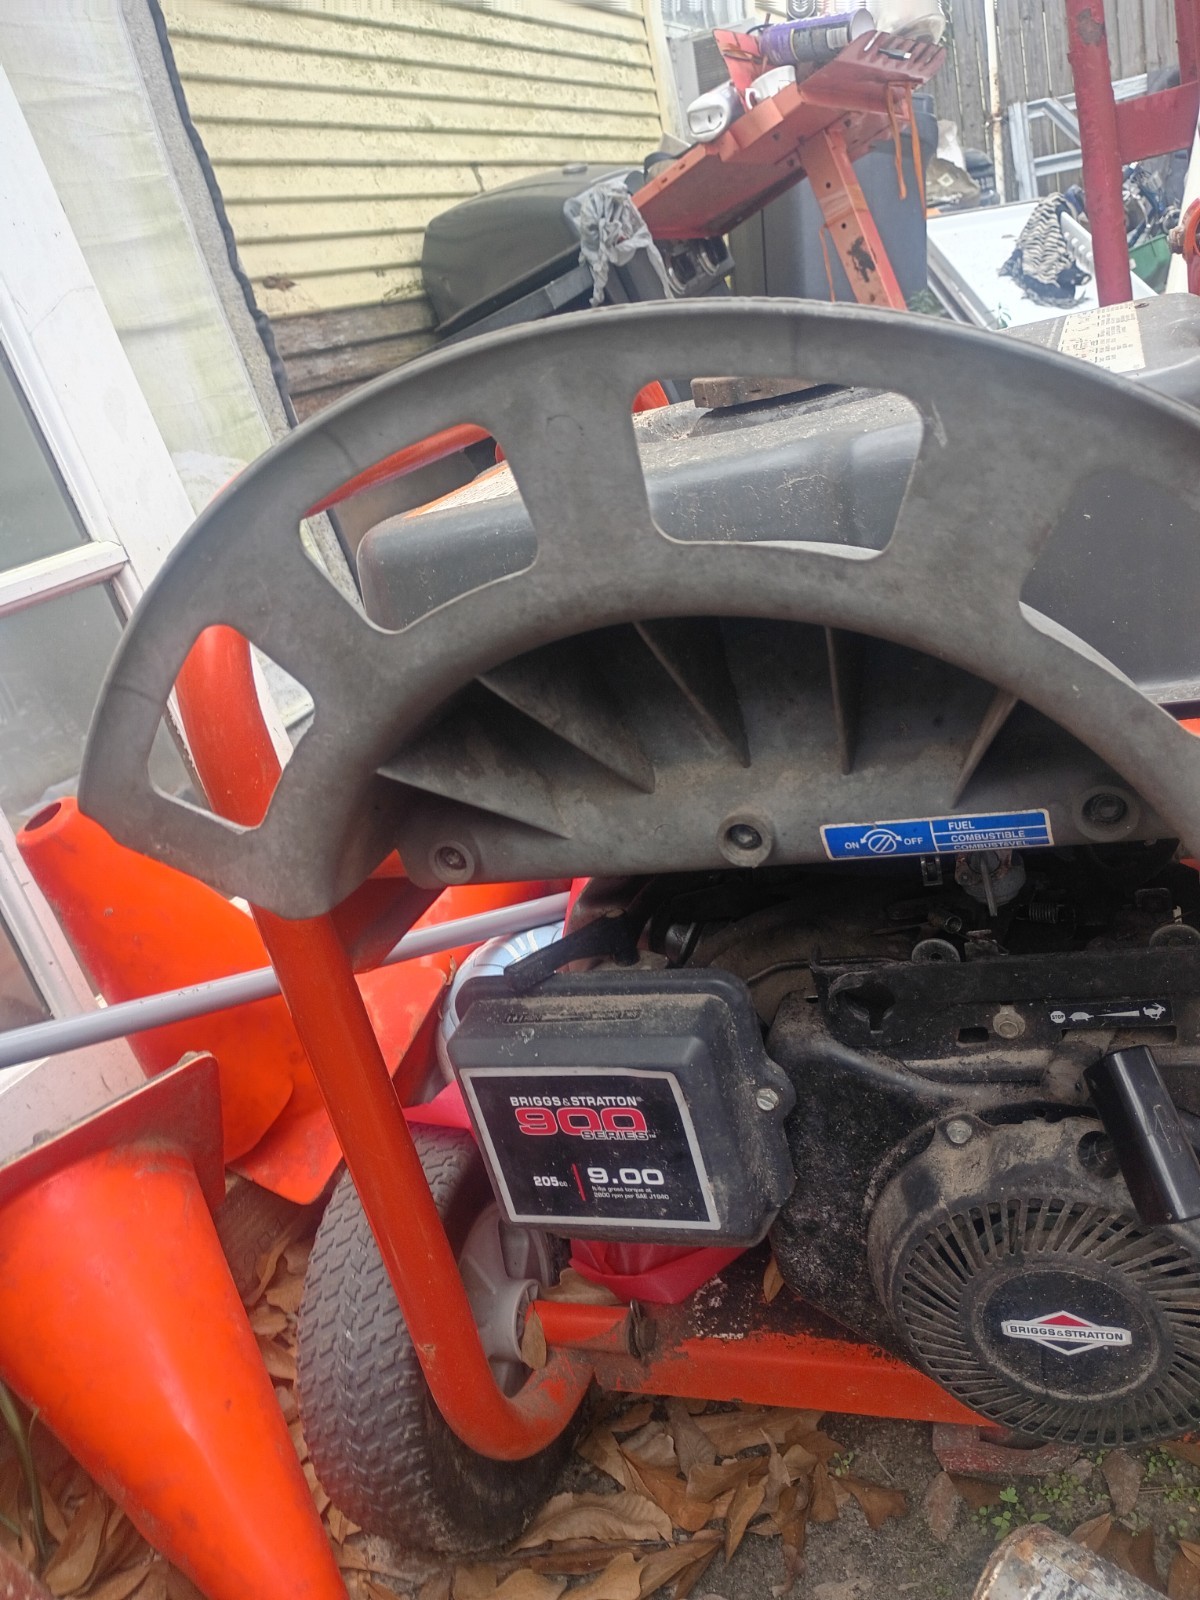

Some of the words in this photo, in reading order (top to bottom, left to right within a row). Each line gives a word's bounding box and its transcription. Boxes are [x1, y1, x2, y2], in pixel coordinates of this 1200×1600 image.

[948, 820, 975, 831] FUEL
[904, 837, 924, 846] OFF
[950, 830, 1026, 843] COMBUSTIBLE
[844, 841, 860, 850] ON
[515, 1107, 647, 1136] 900
[588, 1168, 664, 1184] 9.00
